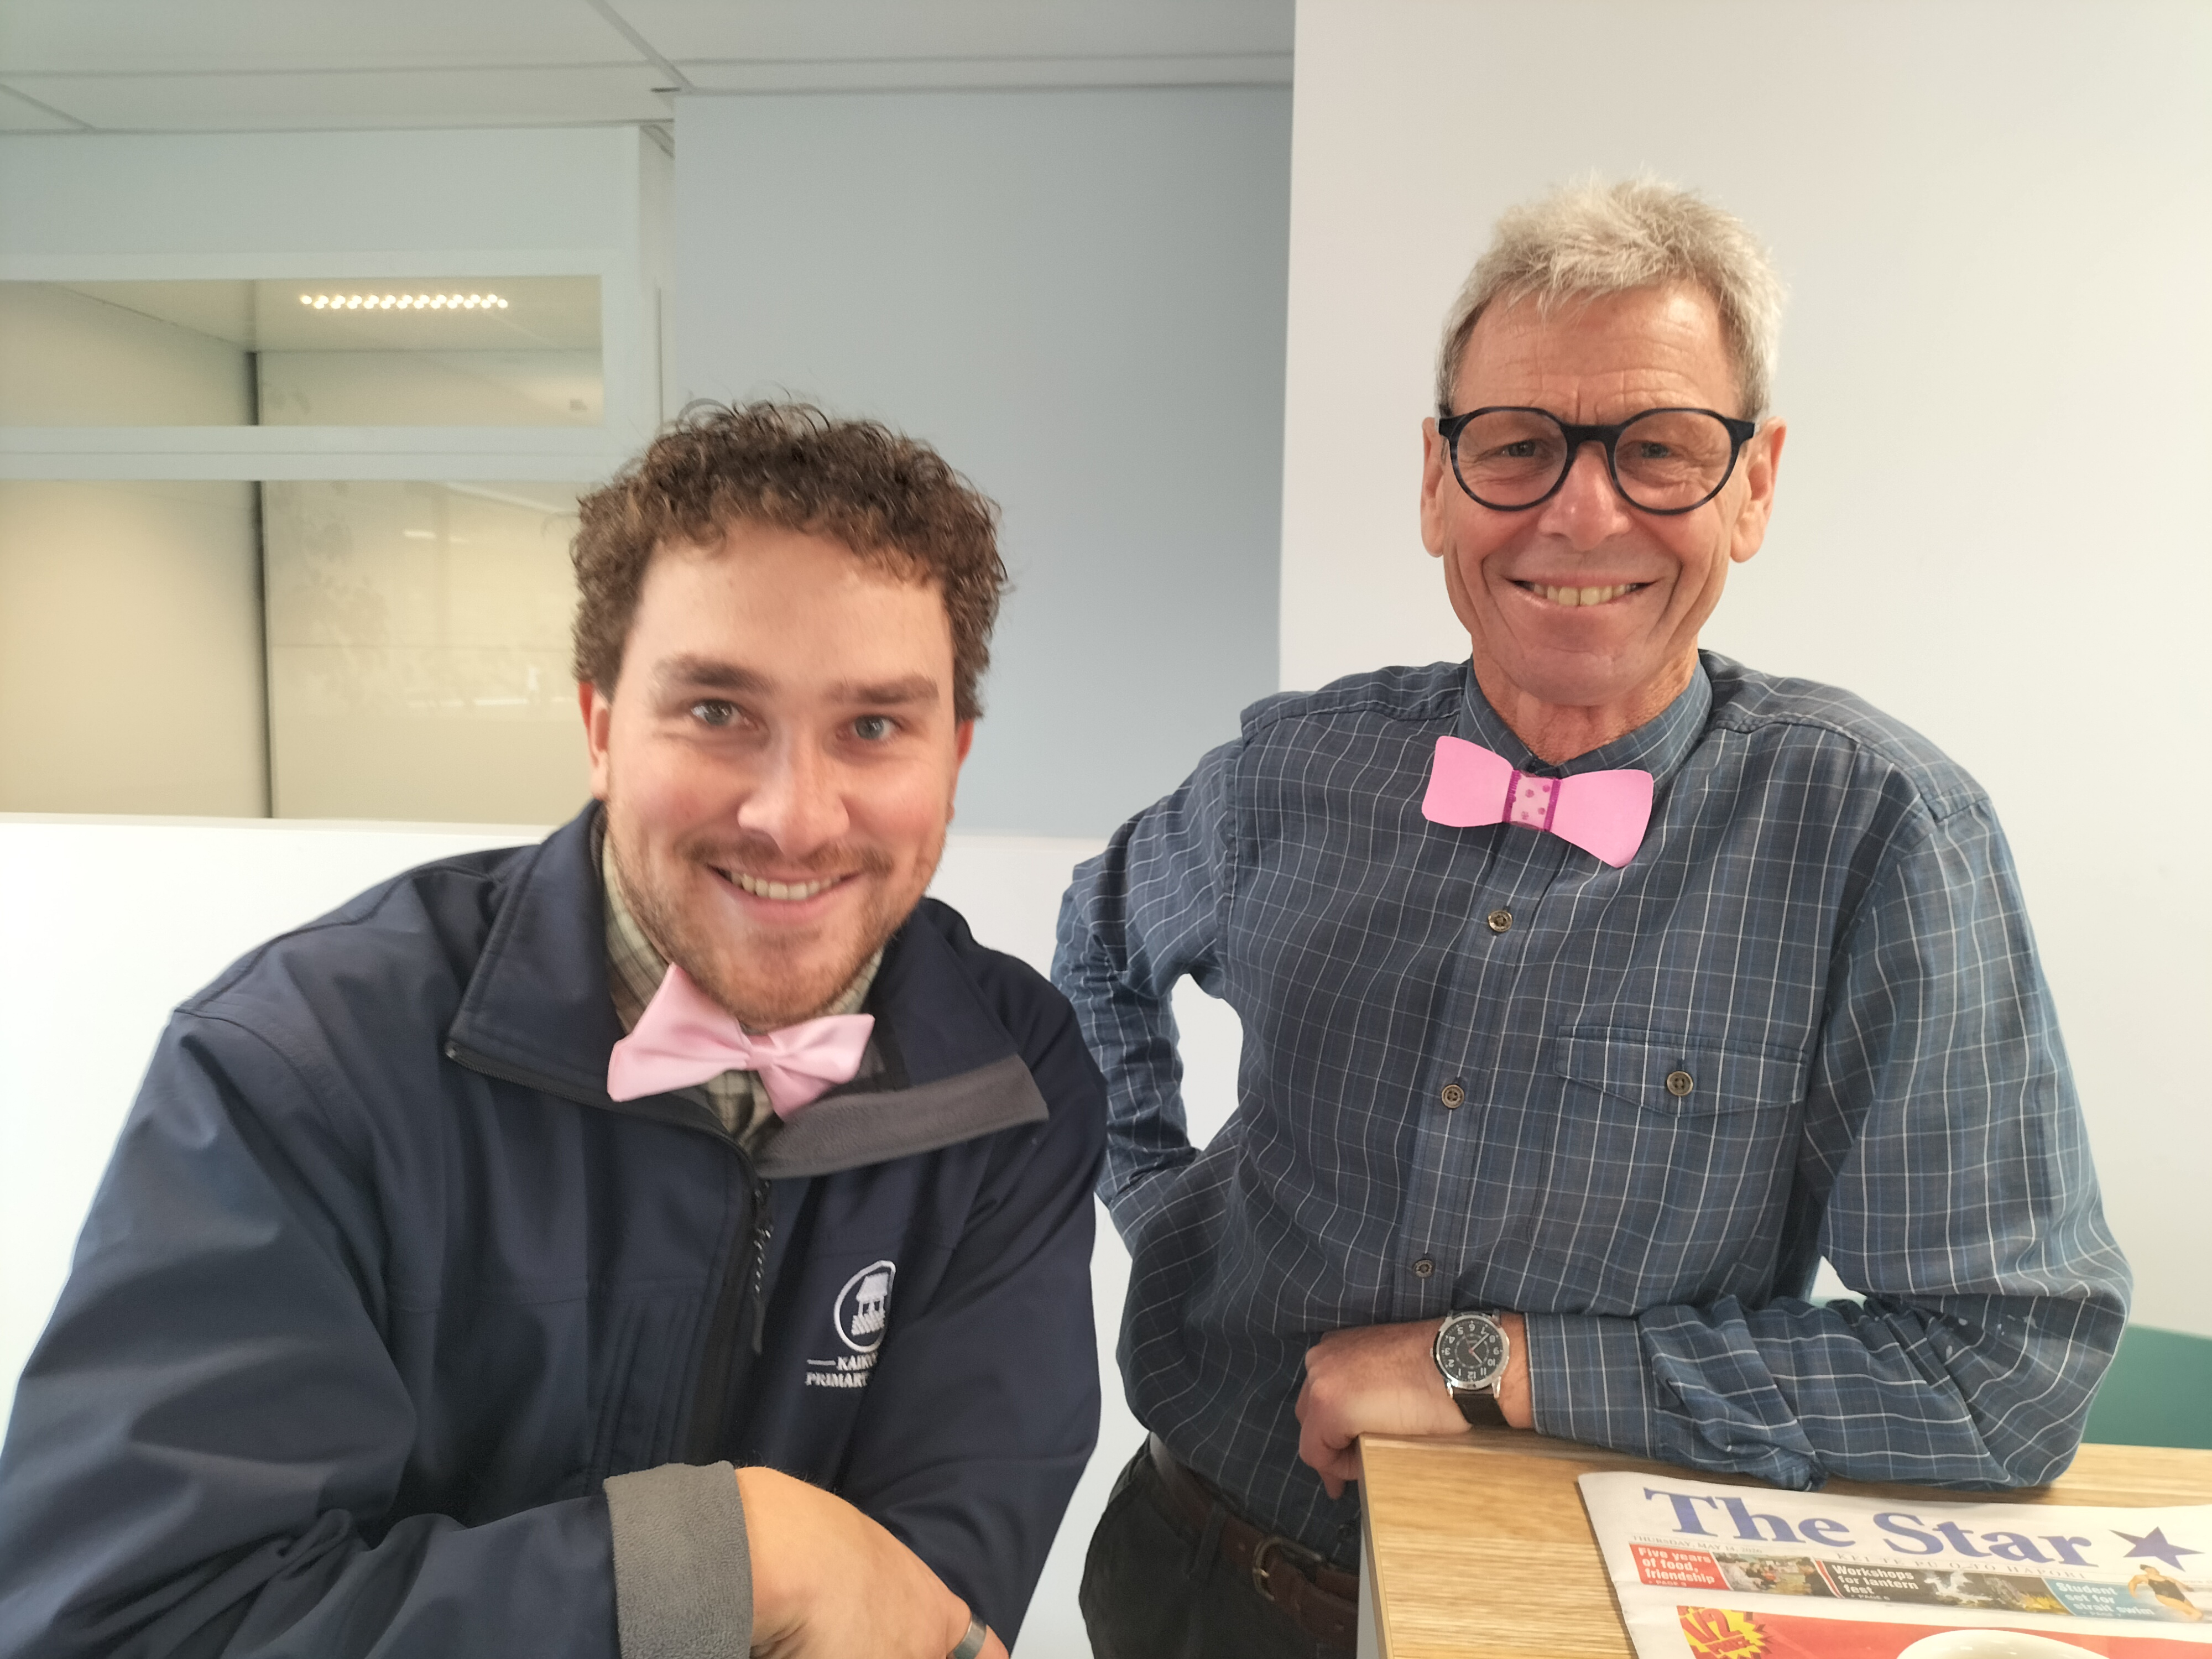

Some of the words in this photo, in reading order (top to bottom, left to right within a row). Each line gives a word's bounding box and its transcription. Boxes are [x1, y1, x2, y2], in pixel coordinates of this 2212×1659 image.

[1457, 1327, 1464, 1335] 5
[1444, 1347, 1451, 1355] 3
[1448, 1359, 1454, 1368] 2
[1487, 1358, 1496, 1366] 10
[1458, 1368, 1462, 1376] 1
[1468, 1371, 1477, 1379] 12
[1480, 1368, 1487, 1376] 11
[1643, 1487, 1856, 1547] The
[1873, 1512, 2099, 1568] Star
[1638, 1547, 1668, 1559] Five
[1671, 1552, 1712, 1563] years
[1642, 1558, 1656, 1568] of
[1660, 1559, 1699, 1573] food,
[1645, 1568, 1715, 1584] friendship
[1832, 1564, 1914, 1580] Workshops
[1838, 1575, 1859, 1584] for
[1863, 1577, 1919, 1589] lantern
[1843, 1584, 1875, 1594] fest
[2056, 1582, 2118, 1595] Student
[2064, 1593, 2090, 1603] set
[2091, 1595, 2116, 1604] for
[2073, 1603, 2115, 1613] strait
[2116, 1606, 2156, 1615] swim
